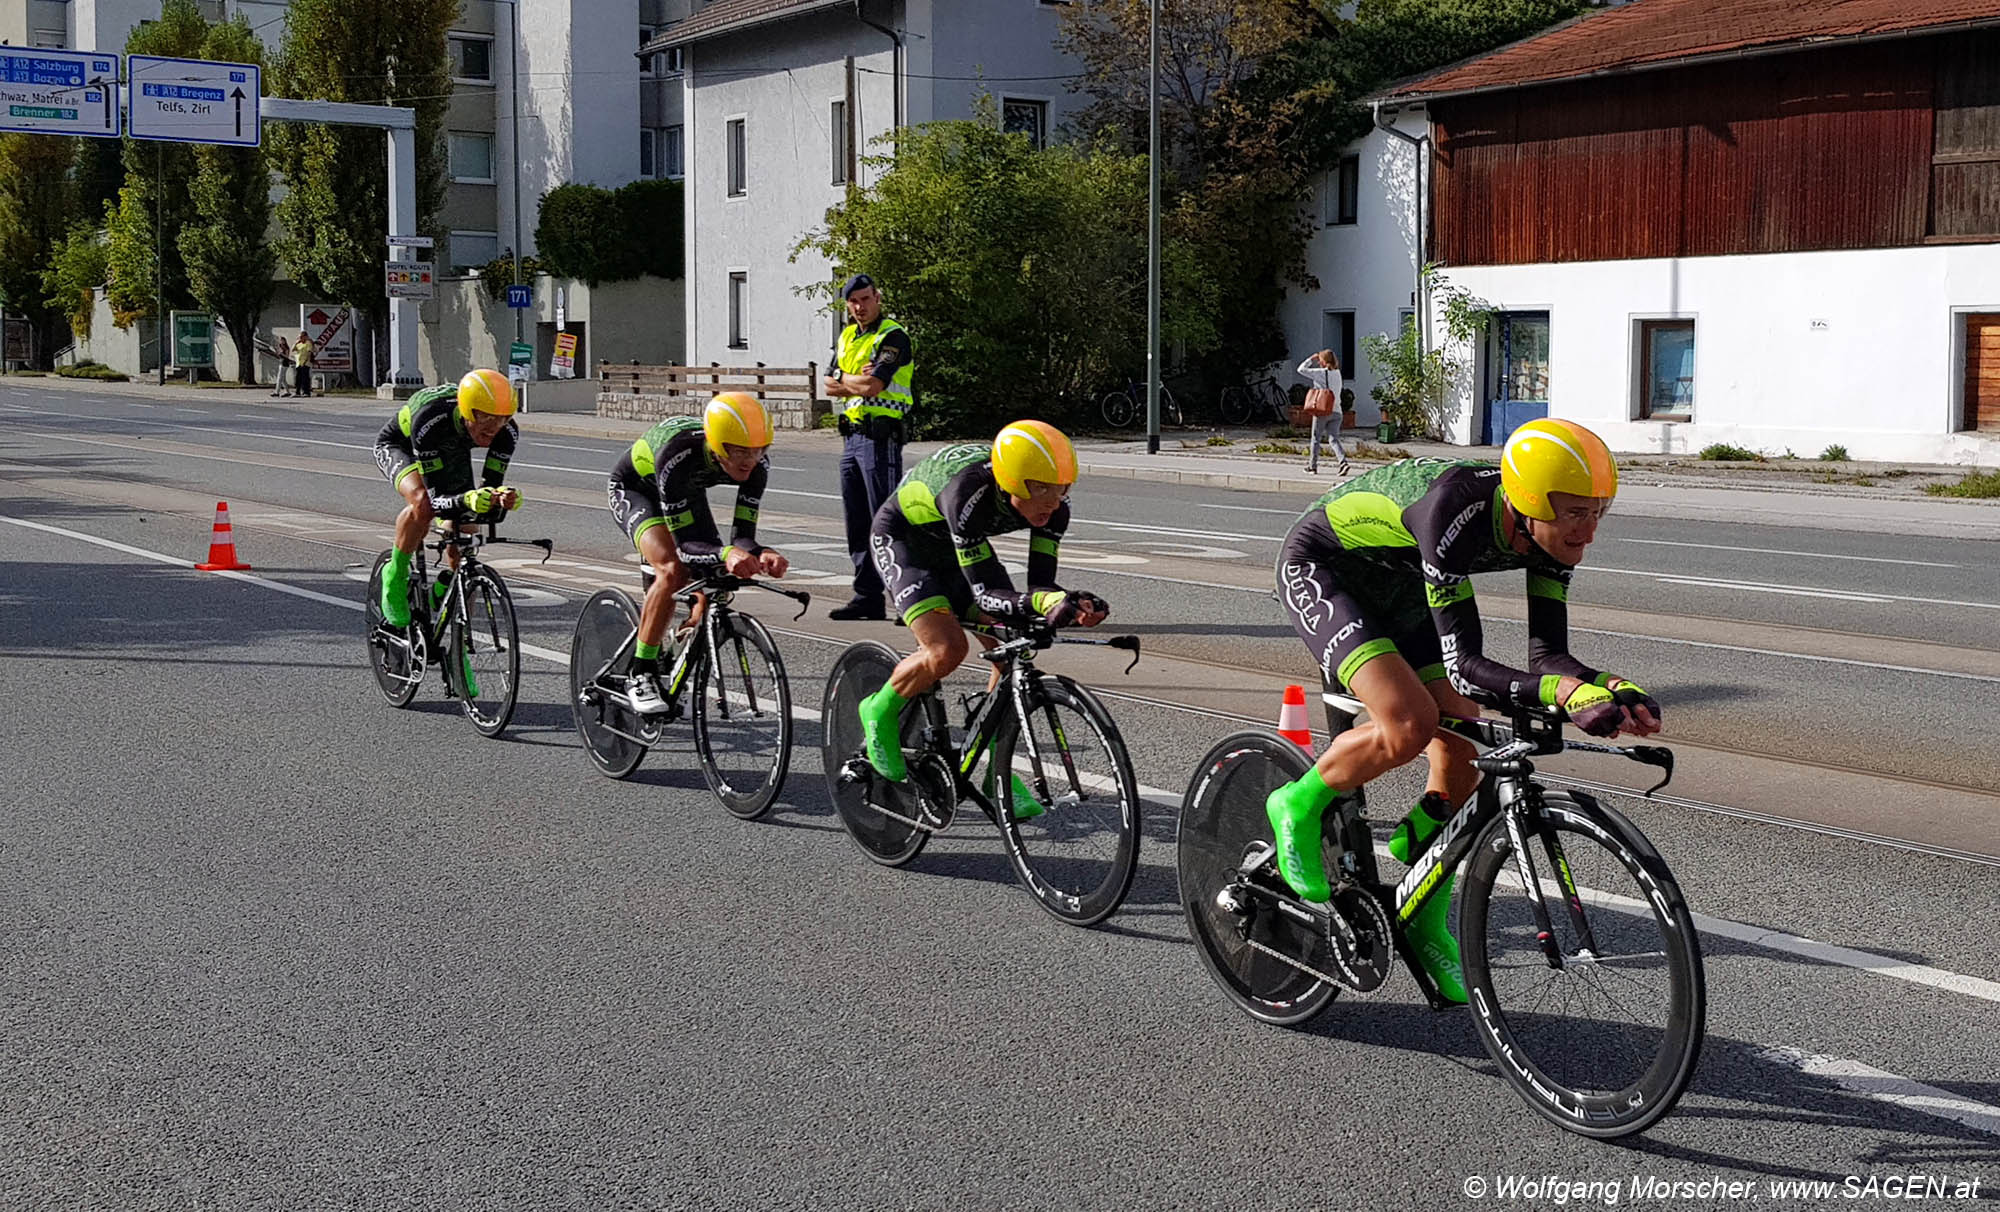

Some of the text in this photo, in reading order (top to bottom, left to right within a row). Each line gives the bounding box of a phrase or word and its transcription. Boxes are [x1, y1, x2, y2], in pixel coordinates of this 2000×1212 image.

[33, 61, 79, 72] Salzburg
[95, 63, 108, 71] 174
[232, 73, 244, 81] 171
[32, 93, 63, 105] Matrei
[87, 93, 101, 101] 182
[181, 89, 222, 100] Bregenz
[13, 107, 74, 118] Brenner 182
[156, 101, 211, 114] Telfs, Zirl
[510, 290, 527, 303] 171
[1436, 500, 1486, 559] MERIDA
[1286, 564, 1321, 630] DUKLA
[1396, 790, 1479, 910] MERIDA
[1396, 860, 1444, 928] MERIDA
